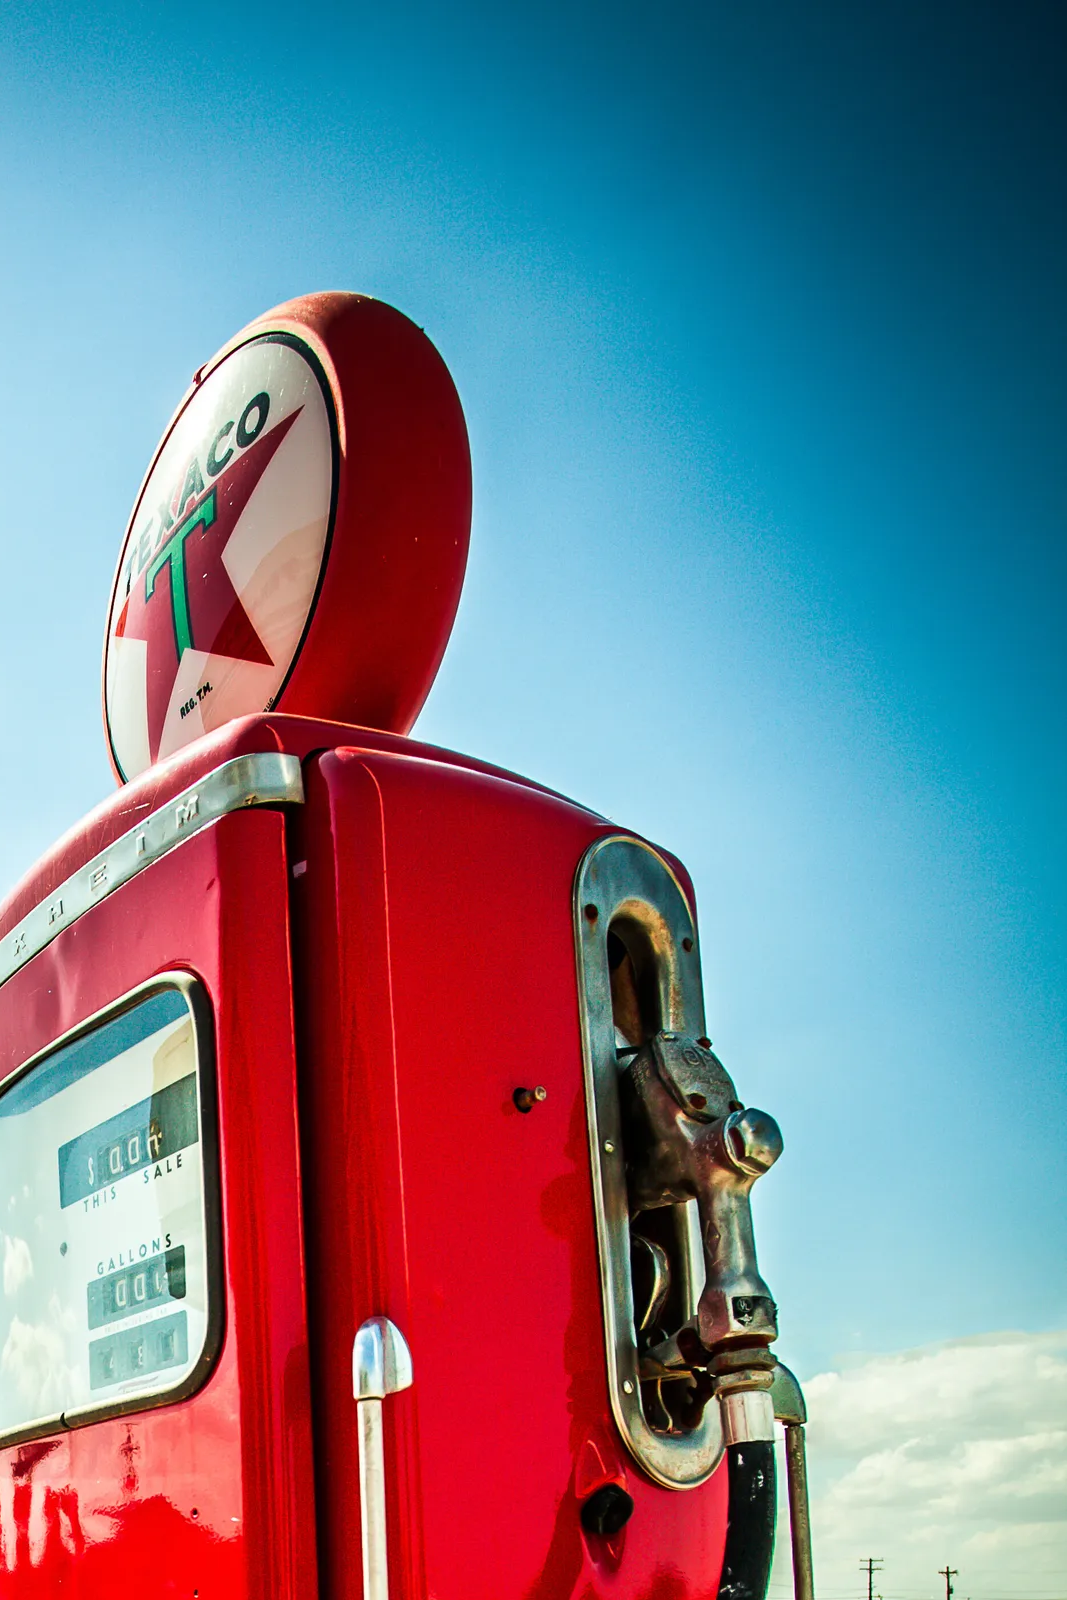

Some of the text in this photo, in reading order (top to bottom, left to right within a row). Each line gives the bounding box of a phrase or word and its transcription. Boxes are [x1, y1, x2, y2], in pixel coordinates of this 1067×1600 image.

[125, 391, 270, 597] TEXACO
[83, 1153, 183, 1213] THIS SALE
[96, 1233, 172, 1275] GALLONS
